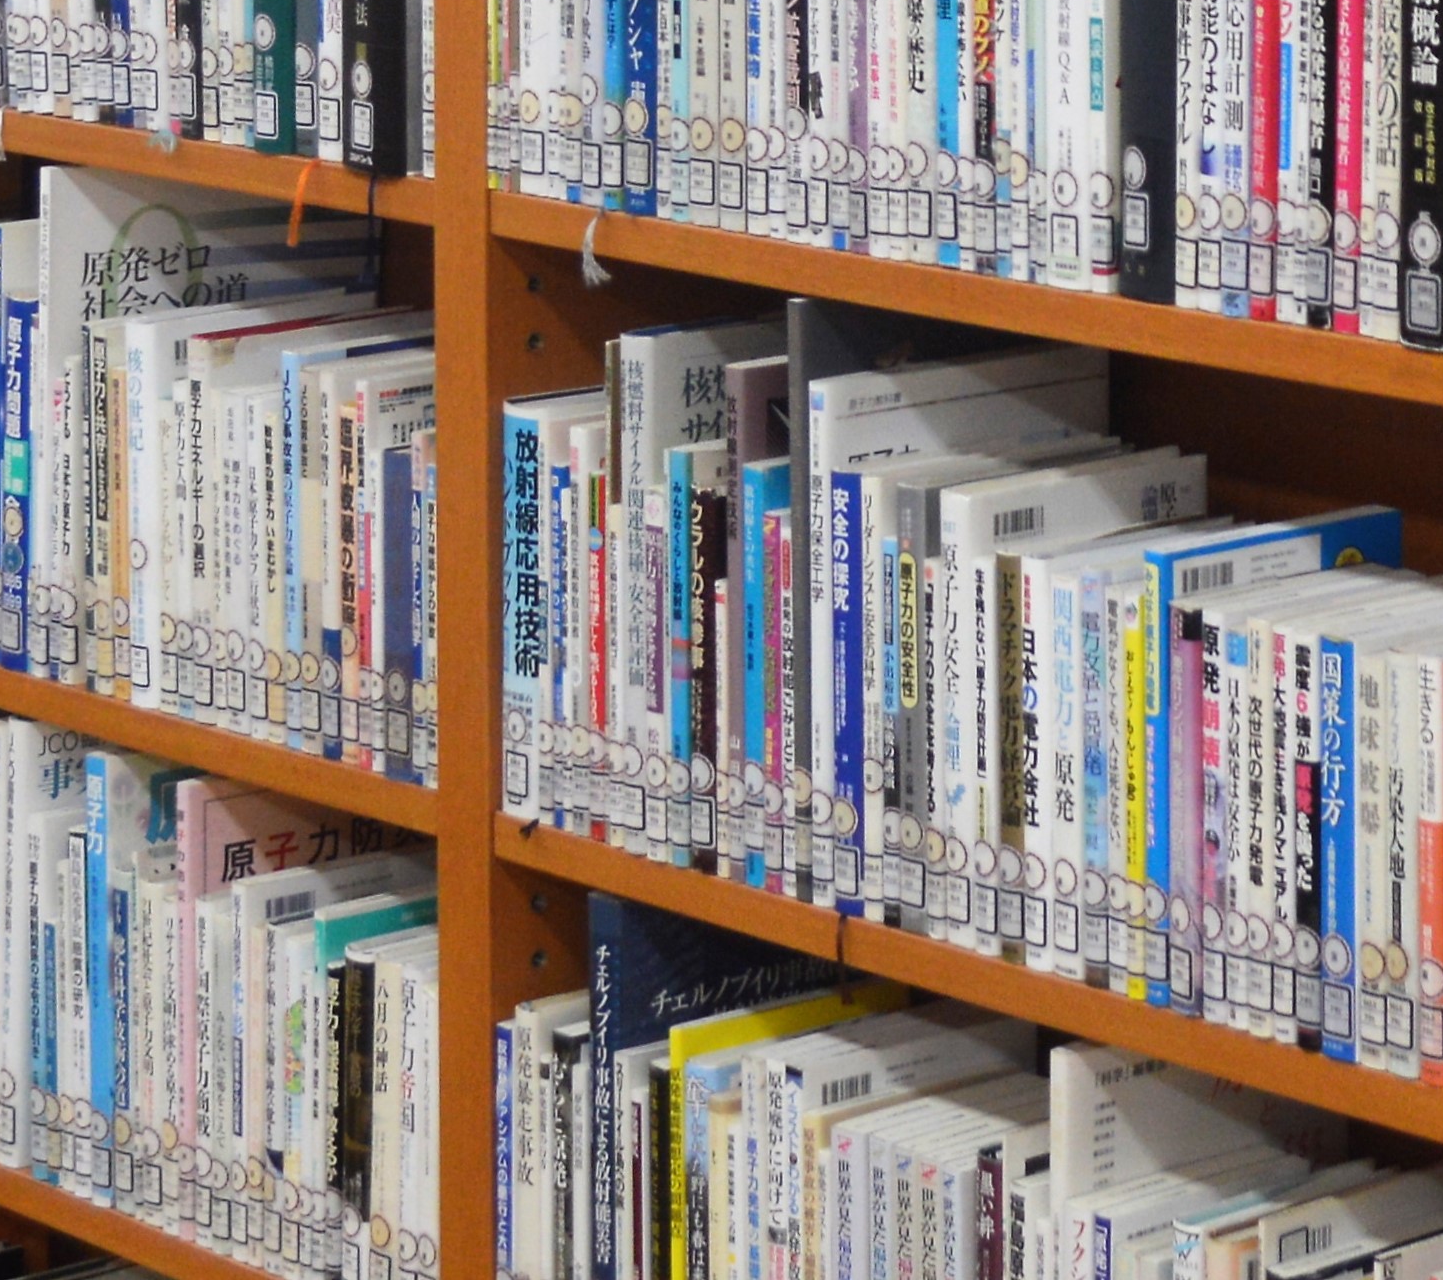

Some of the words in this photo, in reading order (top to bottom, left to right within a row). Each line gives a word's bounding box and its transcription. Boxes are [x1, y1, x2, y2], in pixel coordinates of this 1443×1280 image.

[81, 244, 212, 287] 原発ゼロ
[190, 380, 205, 580] 原子力エネルギーの選択
[514, 429, 540, 679] 放射線応用技術
[831, 486, 850, 612] 安全の探究
[900, 563, 916, 700] 原子力の安全性
[1023, 628, 1039, 829] 日本の電力会社
[1321, 653, 1346, 827] 国策の行方
[87, 774, 104, 856] 原子力
[517, 1026, 534, 1187] 原発暴走事故
